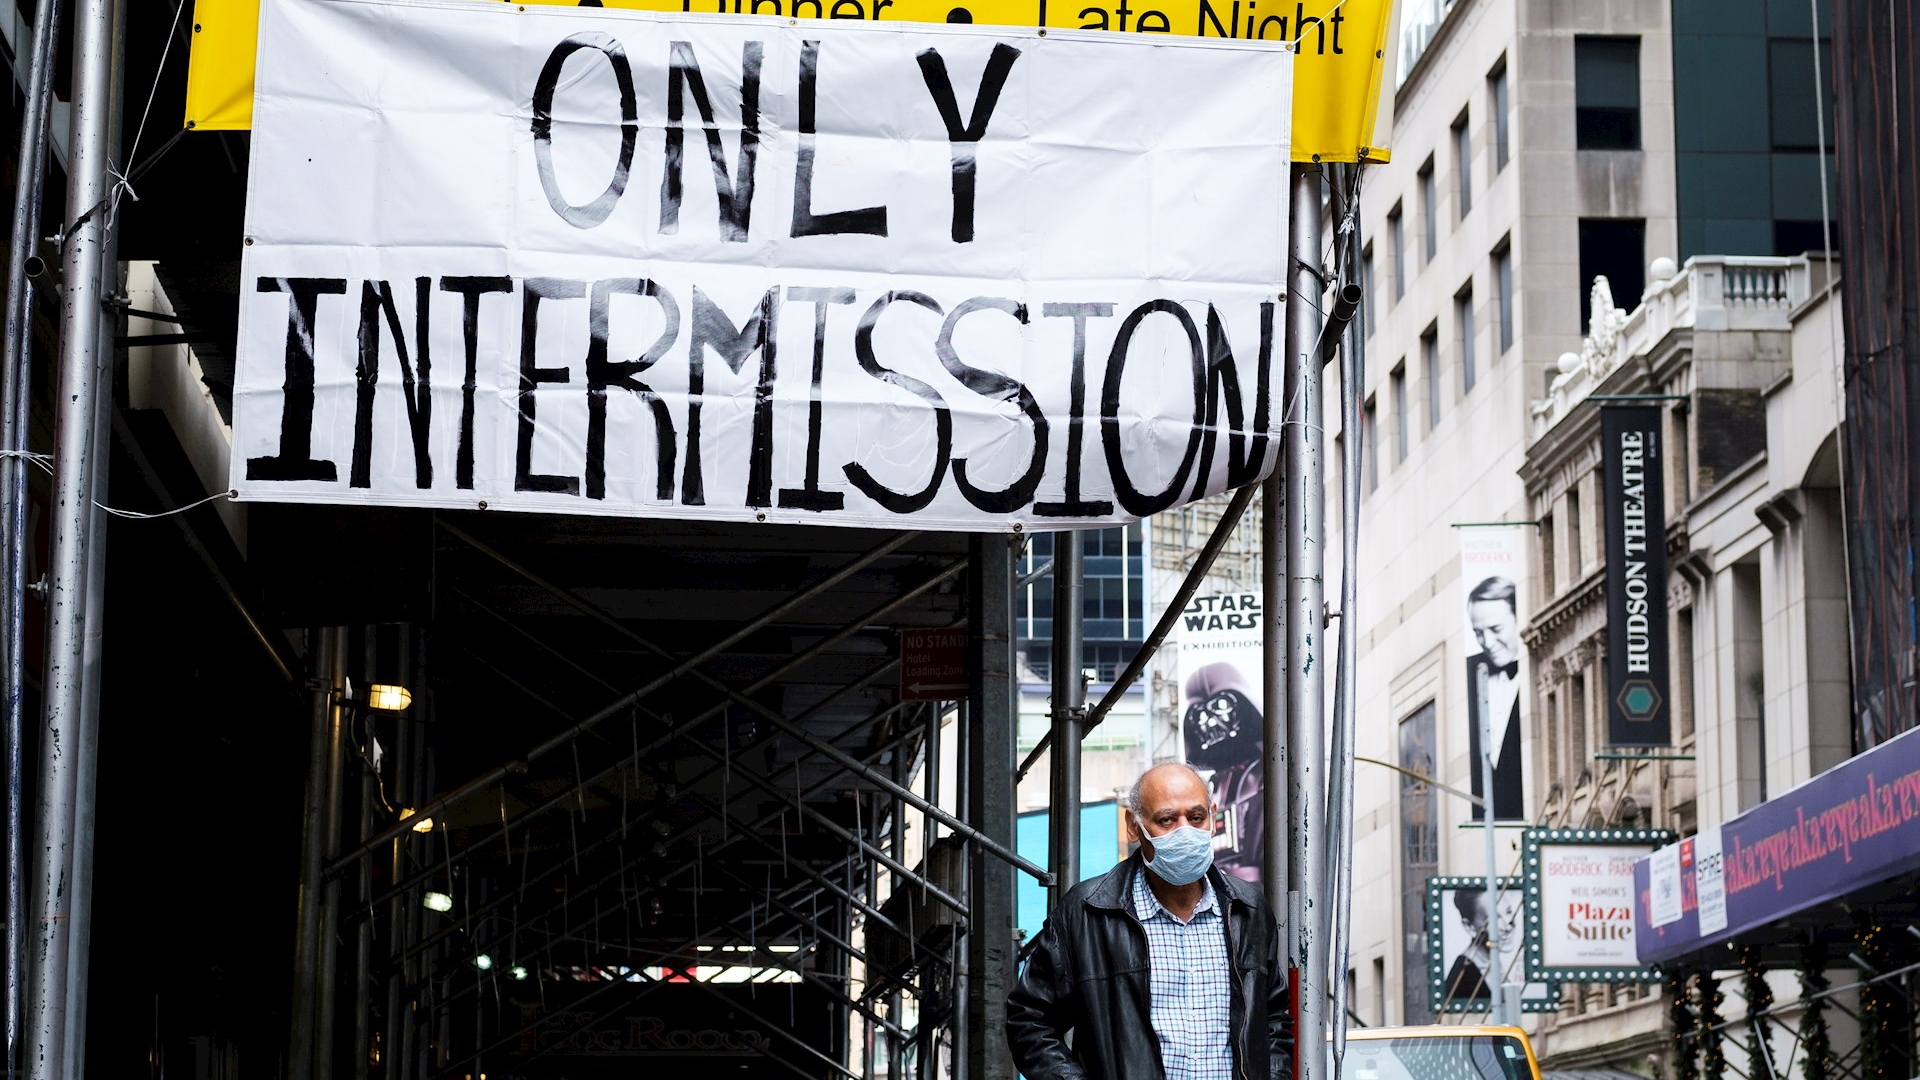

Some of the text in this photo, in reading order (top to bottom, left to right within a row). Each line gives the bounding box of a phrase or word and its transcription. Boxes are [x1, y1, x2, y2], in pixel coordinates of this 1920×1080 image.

[1039, 0, 1171, 33] Late
[1199, 0, 1344, 55] Night
[531, 31, 1021, 243] ONLY
[246, 276, 1274, 517] INTERMISSION
[1621, 431, 1650, 673] HUDSON THEATRE
[1184, 595, 1261, 613] STAR
[1184, 613, 1261, 632] WARS
[907, 636, 923, 648] NO
[1183, 640, 1262, 650] EXHIBITION
[907, 653, 930, 664] Hotel
[907, 666, 940, 678] Loading
[1549, 862, 1602, 876] BRODERICK
[1569, 903, 1631, 920] Plaza
[1567, 922, 1632, 940] Suite
